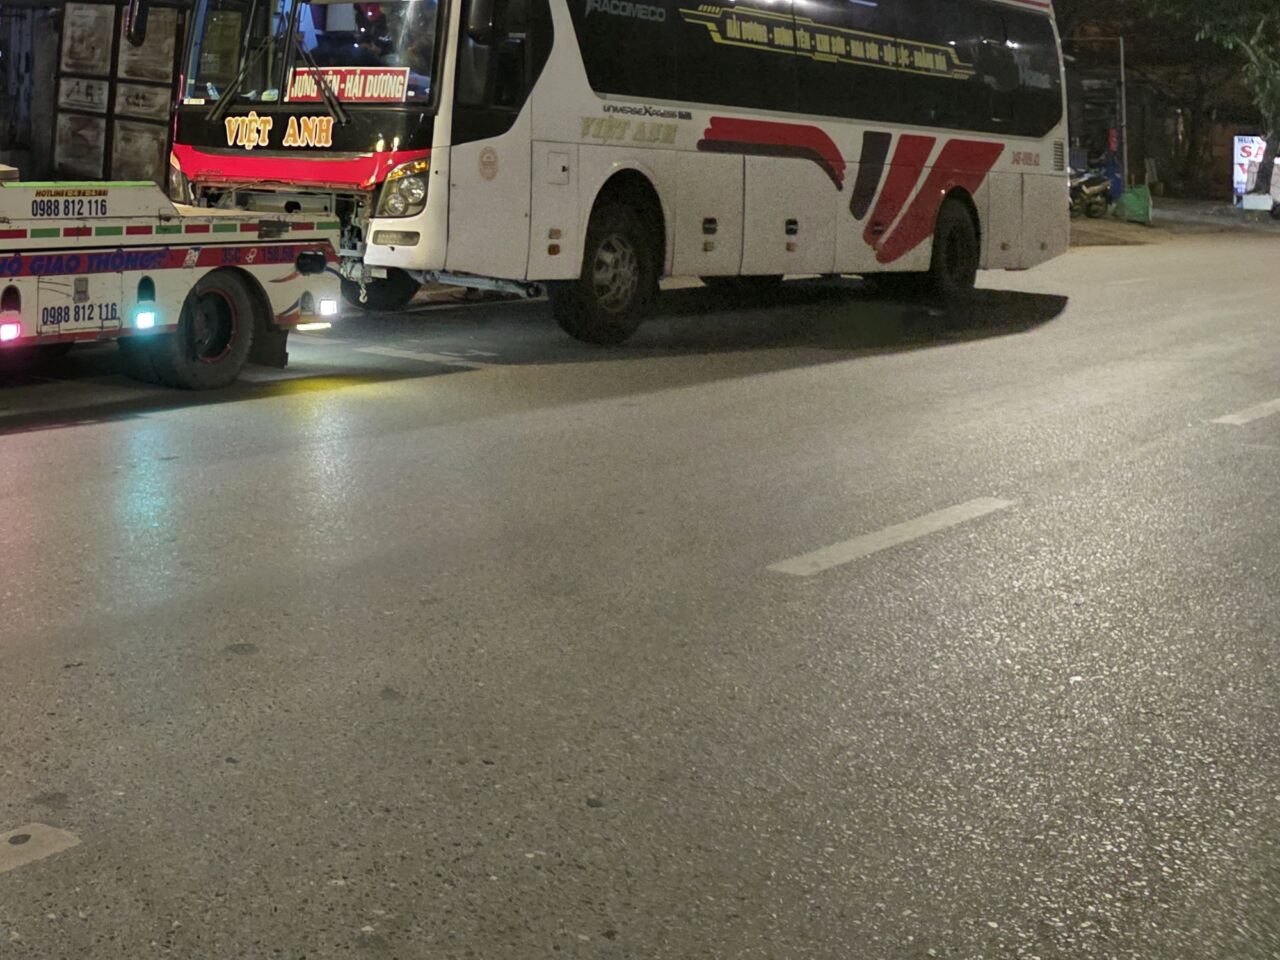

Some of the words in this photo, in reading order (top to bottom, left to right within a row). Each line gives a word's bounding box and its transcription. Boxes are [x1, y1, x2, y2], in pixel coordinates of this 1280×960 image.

[365, 72, 404, 98] DƯƠNG
[225, 111, 273, 150] VIỆT
[282, 116, 334, 147] ANH
[31, 199, 60, 217] 0988
[63, 199, 84, 217] 812
[87, 199, 107, 216] 116
[29, 253, 81, 276] GIAO
[41, 306, 70, 325] 0988
[73, 304, 94, 323] 812
[97, 302, 117, 321] 116
